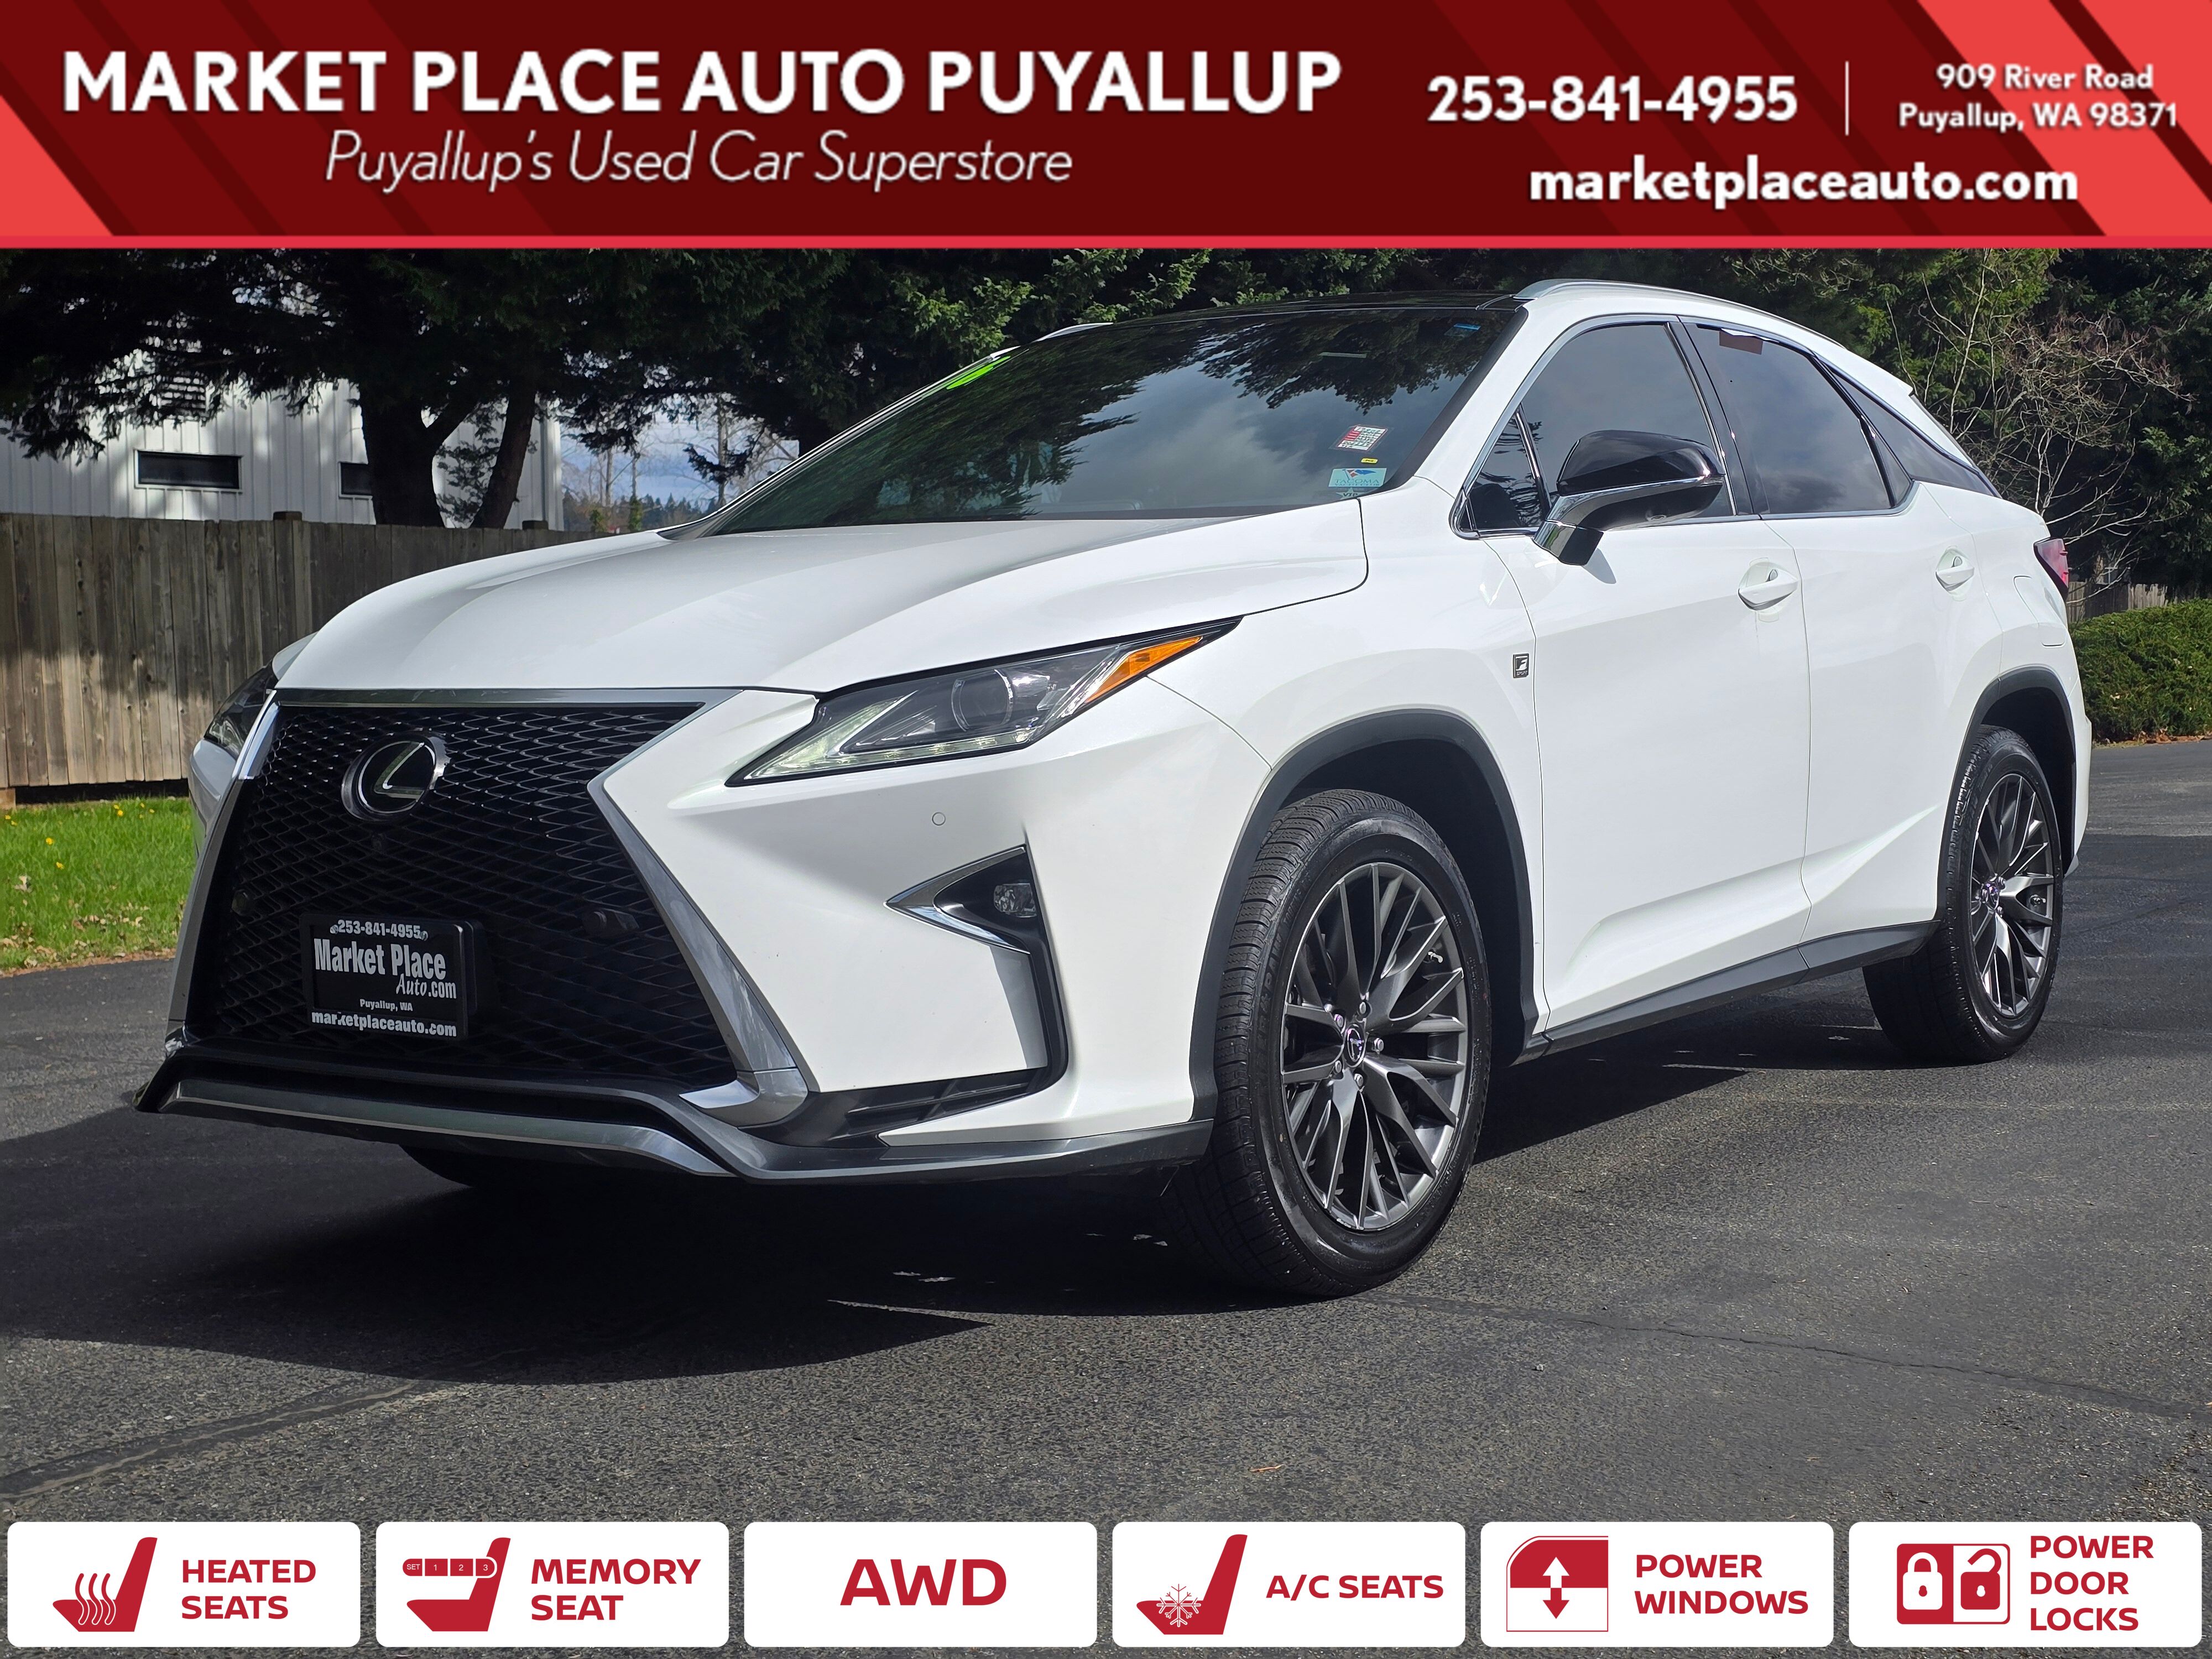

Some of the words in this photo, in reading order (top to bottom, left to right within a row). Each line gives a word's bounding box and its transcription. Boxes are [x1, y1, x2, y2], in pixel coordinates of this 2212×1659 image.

[337, 919, 421, 938] 253-841-4955
[314, 938, 385, 975] Market
[390, 943, 446, 980] Place
[396, 973, 457, 999] Auto.com
[359, 999, 398, 1011] Puyallup,
[400, 1001, 413, 1011] WA
[311, 1011, 457, 1037] marketplaceauto.com
